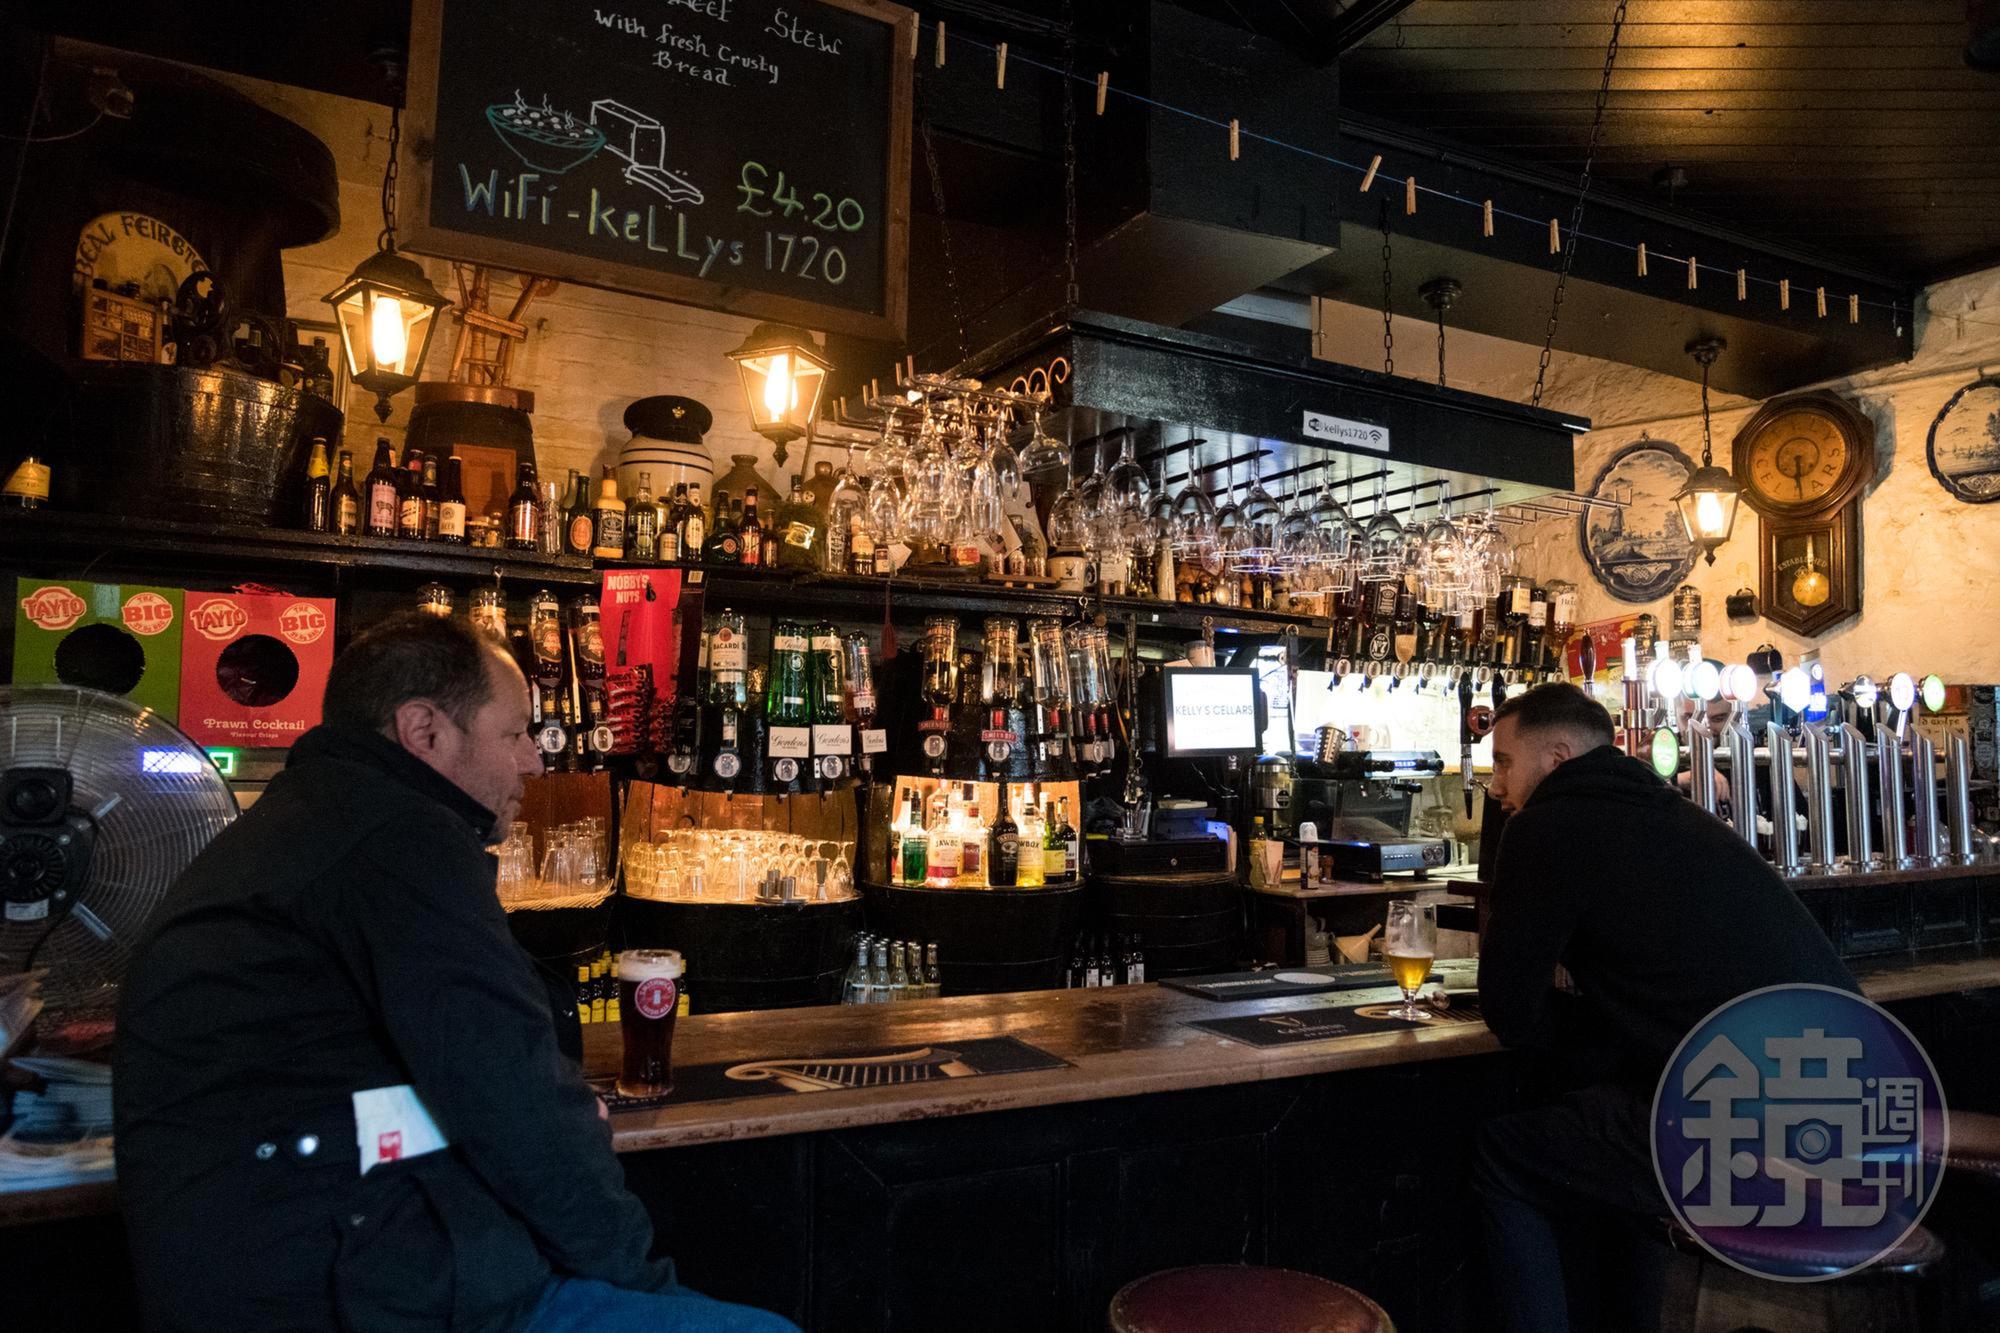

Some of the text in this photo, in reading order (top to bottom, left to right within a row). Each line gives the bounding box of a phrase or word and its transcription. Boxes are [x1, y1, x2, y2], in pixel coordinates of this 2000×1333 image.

[764, 8, 842, 55] Stew
[655, 24, 710, 57] fresh
[718, 44, 779, 84] Crusty
[737, 161, 864, 232] £4.20
[765, 231, 847, 284] 1720
[616, 590, 641, 604] NUTS
[24, 596, 86, 620] TAYTO
[122, 603, 173, 624] BIG
[191, 608, 248, 630] TAYTO
[280, 613, 326, 632] BIG
[713, 642, 740, 650] BACARDI
[1212, 704, 1254, 716] CELLARS
[203, 718, 306, 730] Prawn Cocktail
